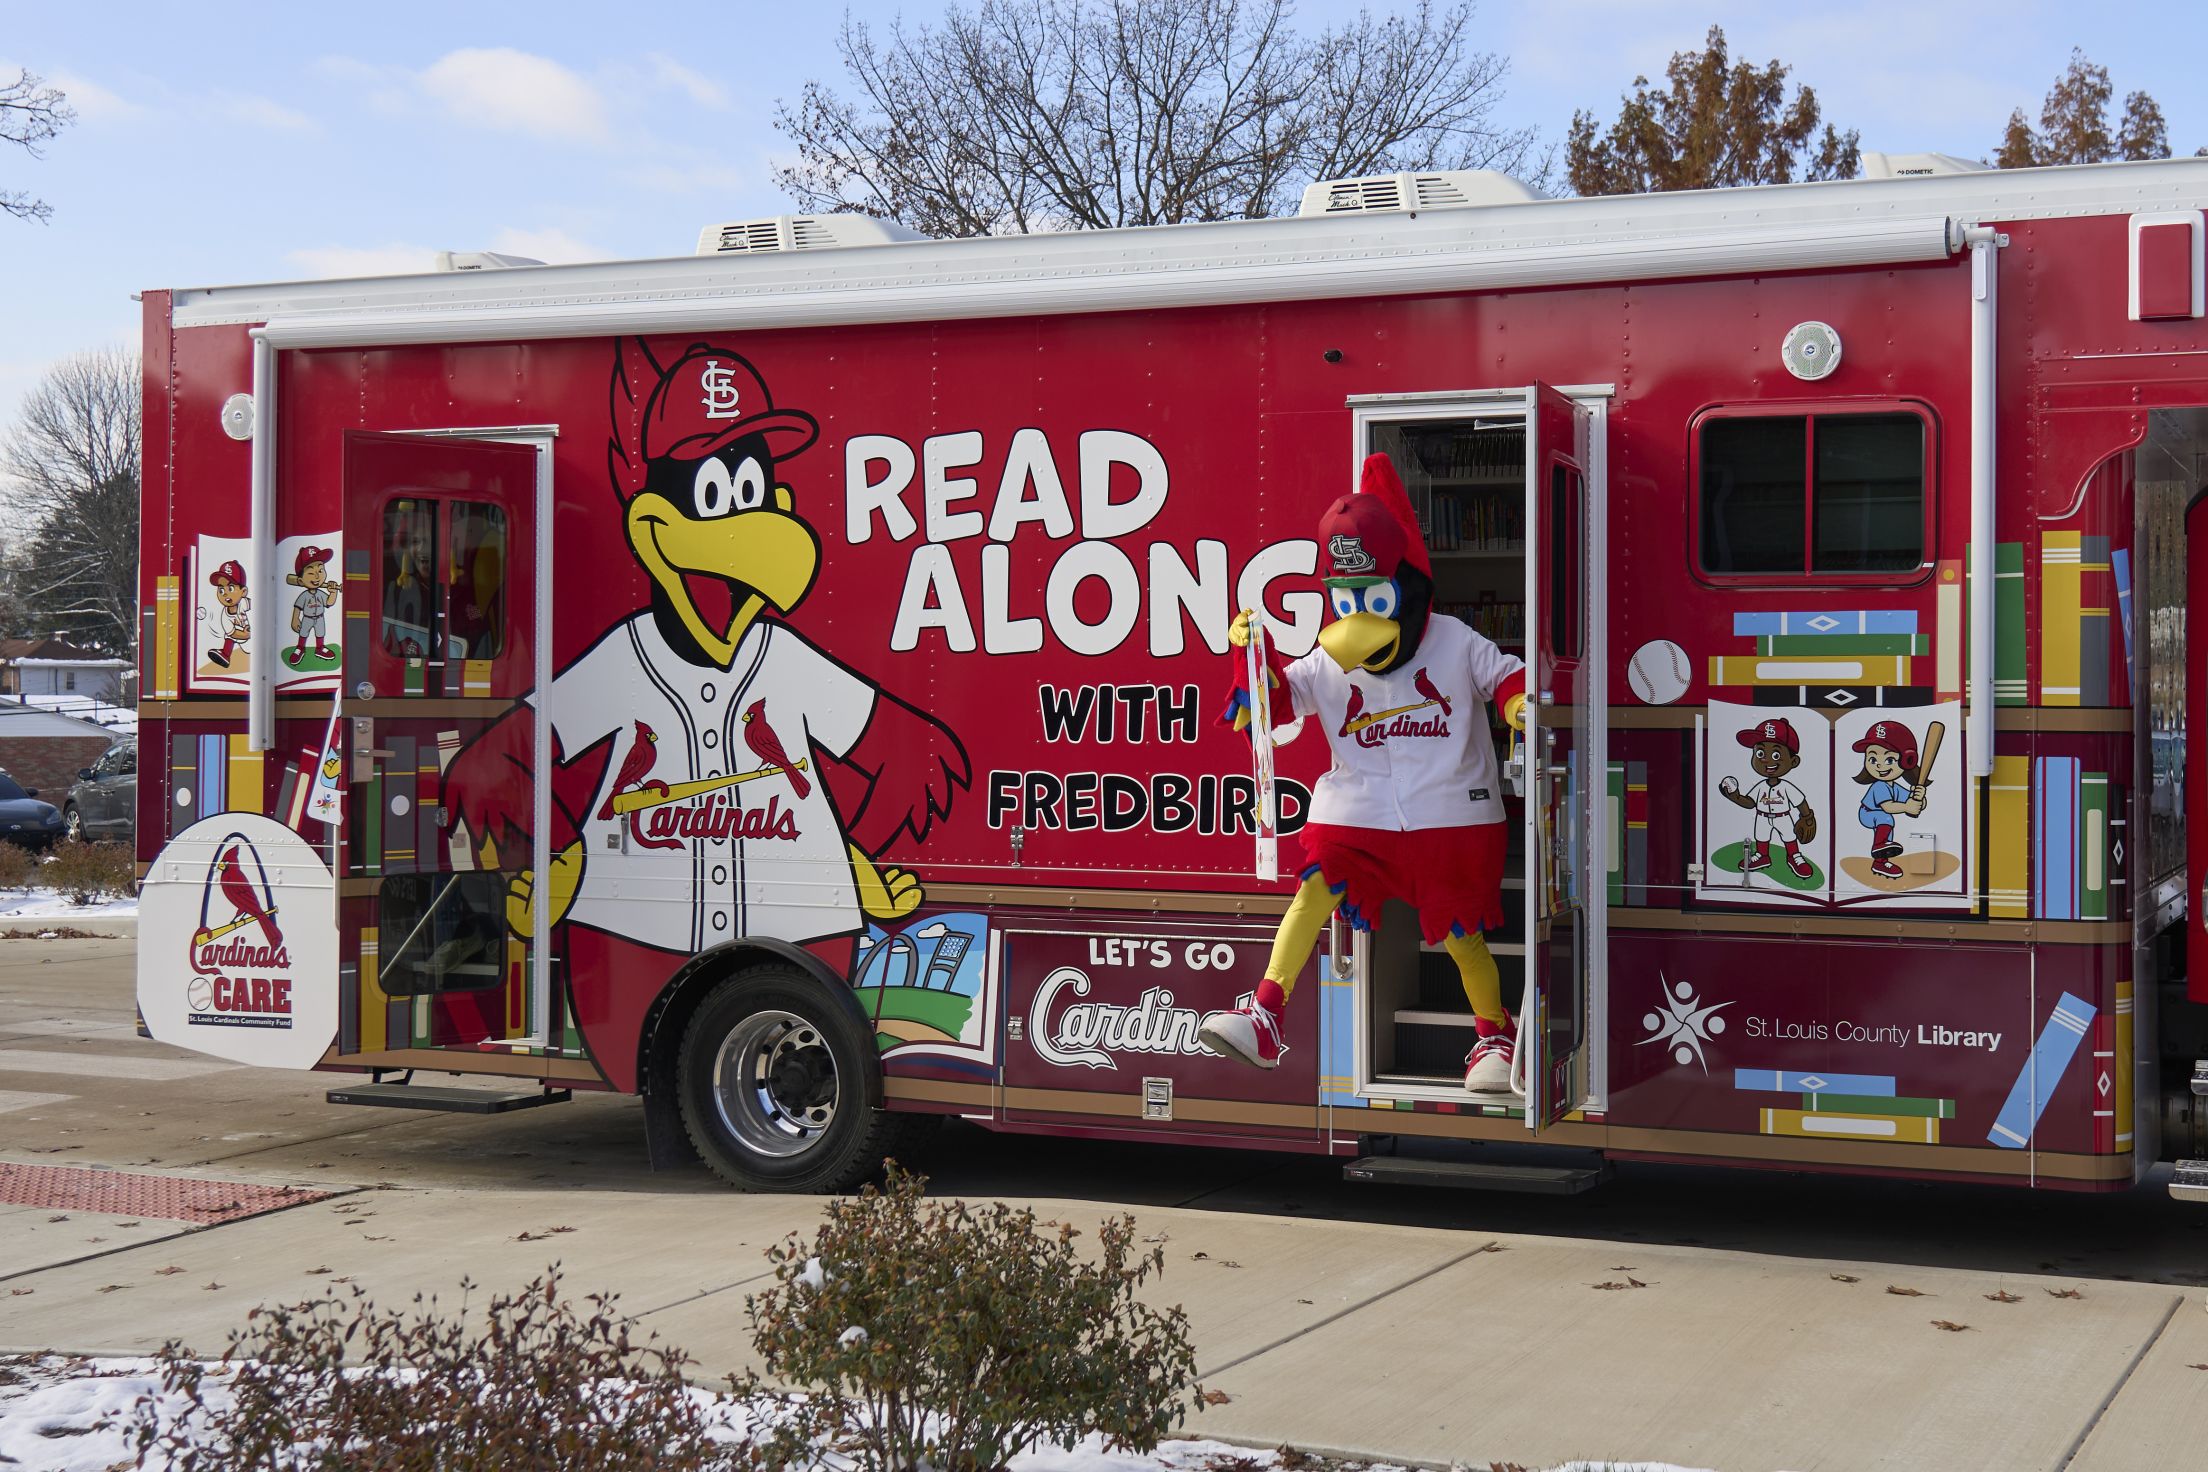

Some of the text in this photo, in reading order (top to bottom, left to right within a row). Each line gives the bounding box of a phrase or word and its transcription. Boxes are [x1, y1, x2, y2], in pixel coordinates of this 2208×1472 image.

[845, 428, 1170, 544] READ
[890, 538, 1325, 658] ALONG
[1039, 684, 1200, 744] WITH
[1355, 713, 1451, 748] Cardinals
[630, 779, 802, 850] Cardinals
[987, 769, 1312, 836] FREDBIRD
[190, 926, 291, 976] Cardinals
[1089, 937, 1236, 971] LET'S GO
[197, 1015, 213, 1023] Louis
[213, 1016, 240, 1025] Cardinals
[240, 1017, 275, 1027] Community
[213, 976, 292, 1014] CARE
[1029, 966, 1290, 1071] Cardin
[1745, 1016, 2002, 1052] St. Louis County Library
